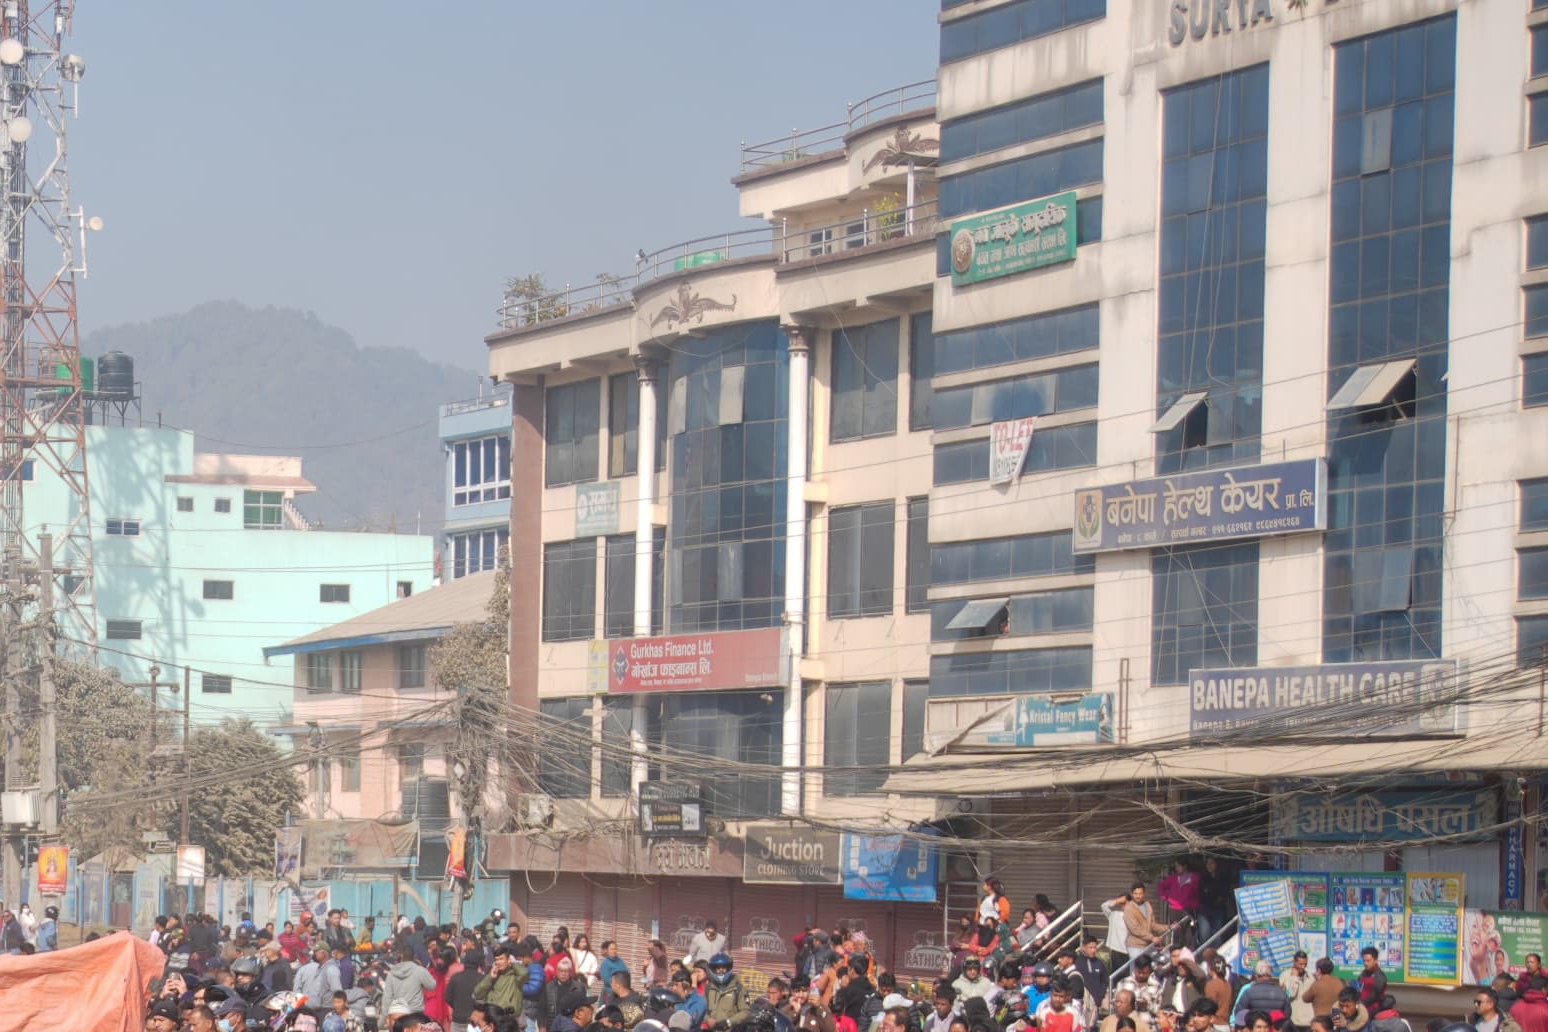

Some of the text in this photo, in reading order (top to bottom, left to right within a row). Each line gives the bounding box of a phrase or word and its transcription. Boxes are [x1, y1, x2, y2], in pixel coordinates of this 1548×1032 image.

[1106, 485, 1157, 526] बनेपा
[1163, 480, 1214, 525] हेल्थ
[1220, 472, 1281, 514] केयर
[630, 639, 714, 659] Gurkhas Finance Ltd.
[1193, 670, 1416, 712] BANEPA HEALTH CARE
[1029, 708, 1098, 724] Kristal Fancy Wear
[760, 836, 824, 860] Juction
[757, 863, 825, 876] CLOTHING STORE
